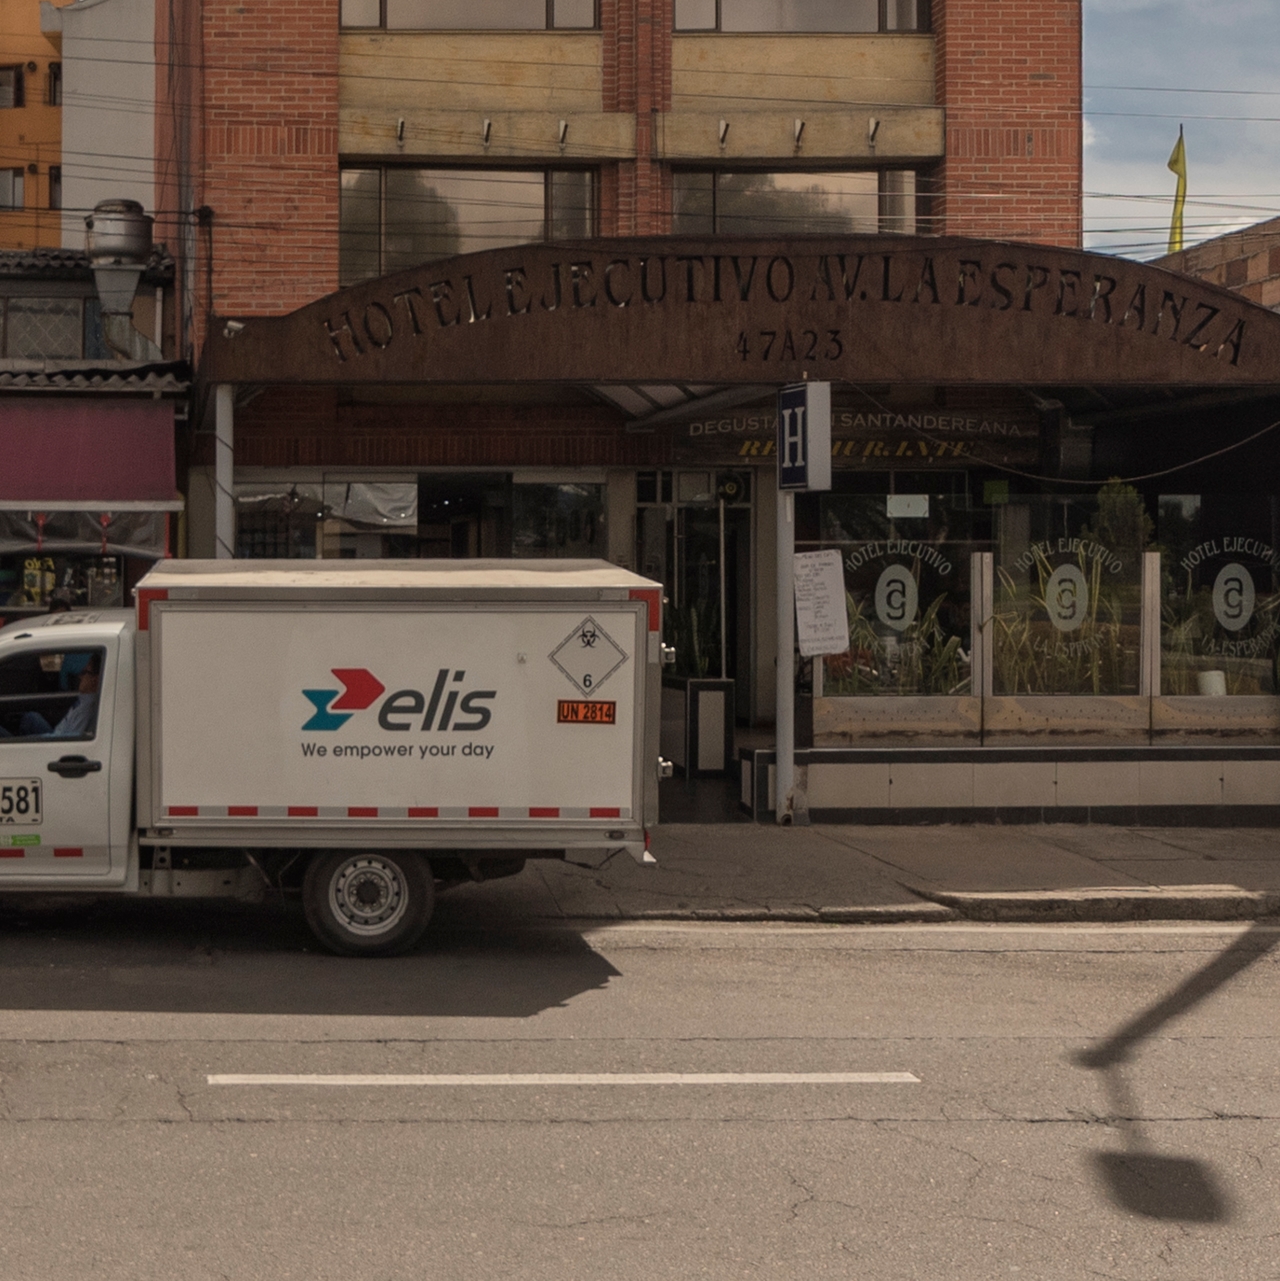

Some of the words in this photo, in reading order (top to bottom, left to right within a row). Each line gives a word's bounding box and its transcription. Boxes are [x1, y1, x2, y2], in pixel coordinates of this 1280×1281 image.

[324, 273, 492, 363] HOTEL
[503, 256, 795, 317] EJECUTIVO
[810, 255, 867, 302] AV.
[878, 255, 941, 304] LA
[954, 259, 1247, 366] ESPERANZA
[782, 406, 806, 468] H
[841, 412, 1021, 436] SANTANDEREANA
[845, 540, 884, 573] HOTEL
[887, 539, 953, 576] EJECUTIVO
[1013, 539, 1054, 573] HOTEL
[1058, 537, 1123, 574] EJECUTIVO
[1180, 539, 1221, 571] HOTEL
[583, 673, 592, 688] 6
[378, 669, 497, 732] elis
[562, 704, 579, 720] UN
[583, 704, 613, 720] 2814
[301, 742, 327, 757] We
[333, 745, 414, 760] empower
[419, 745, 457, 760] your
[461, 742, 494, 759] day
